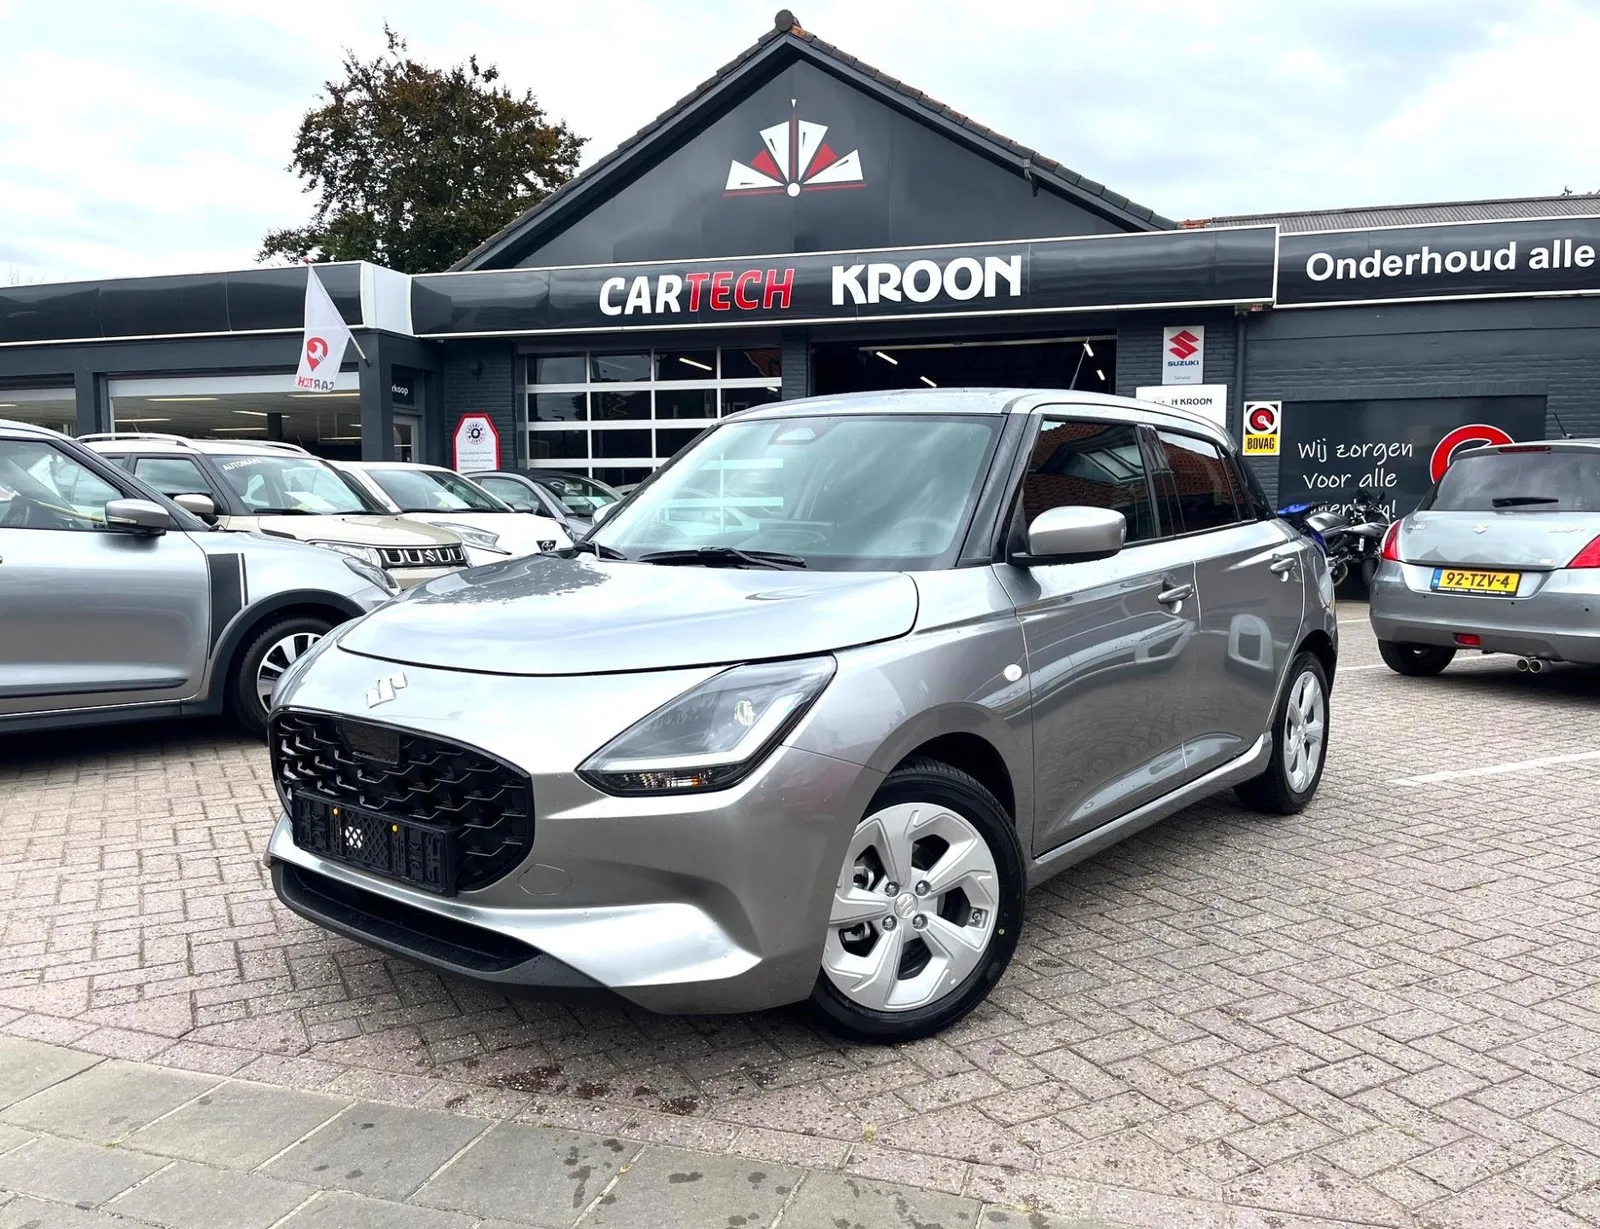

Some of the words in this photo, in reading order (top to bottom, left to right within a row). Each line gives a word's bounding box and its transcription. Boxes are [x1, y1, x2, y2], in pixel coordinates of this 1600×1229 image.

[1306, 241, 1517, 281] Onderhoud
[1528, 239, 1596, 269] alle
[599, 268, 795, 316] CARTECH
[831, 255, 1022, 305] KROON
[1179, 397, 1213, 406] KROON
[1247, 438, 1275, 450] BOVAG
[1297, 437, 1327, 463] Wij
[1335, 442, 1413, 465] zorgen
[1302, 472, 1352, 489] voor
[1358, 467, 1398, 488] alle
[1446, 572, 1510, 589] 92-TZV-4
